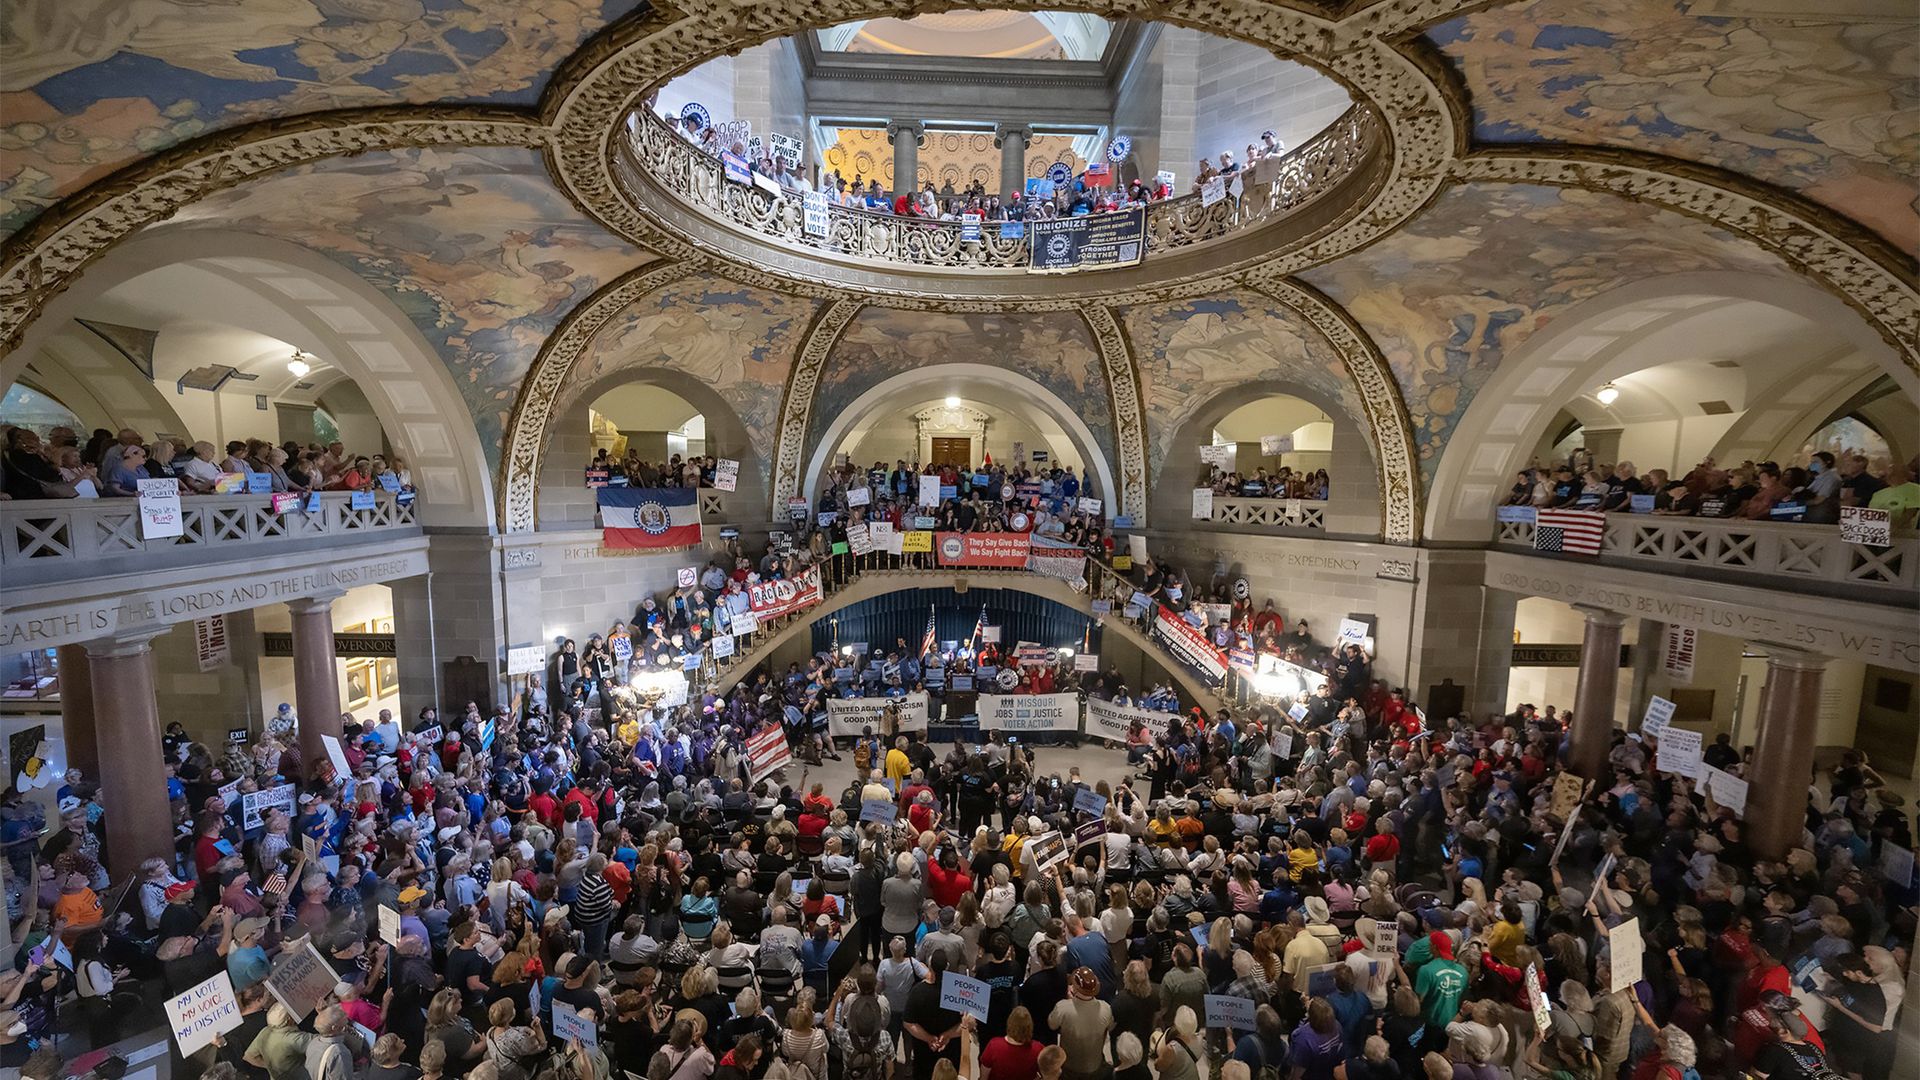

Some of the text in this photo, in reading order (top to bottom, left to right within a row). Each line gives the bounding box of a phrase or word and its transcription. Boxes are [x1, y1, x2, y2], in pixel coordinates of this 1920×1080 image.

[771, 134, 802, 150] STOP THE
[774, 145, 798, 158] POWER
[804, 202, 827, 214] BLOCK
[810, 213, 820, 222] MY
[807, 224, 826, 234] VOTE
[1036, 220, 1087, 230] UNIONIZE
[1078, 251, 1118, 260] TOGETHER
[1840, 508, 1857, 519] IP
[970, 538, 984, 547] They
[985, 539, 996, 547] Say
[981, 550, 992, 558] Say
[994, 549, 1010, 558] Fight
[1253, 552, 1284, 564] PARTY
[1288, 554, 1360, 570] EXPEDIENCY
[90, 610, 108, 630] IS
[111, 603, 156, 625] THE
[161, 590, 225, 616] LORD'S
[230, 584, 268, 604] AND
[270, 578, 300, 597] THE
[303, 568, 358, 590] FULLNESS
[1500, 572, 1528, 588] LORD
[1532, 578, 1562, 595] GOD
[1565, 584, 1584, 597] OF
[1588, 587, 1632, 608] HOSTS
[1636, 596, 1652, 612] BE
[1657, 598, 1704, 622] WITH
[1712, 610, 1733, 628] US
[1840, 630, 1882, 656] WE
[197, 620, 210, 661] Missouri
[1160, 634, 1172, 645] THE
[1171, 643, 1197, 665] SUPREME
[1176, 636, 1187, 645] THE
[1187, 644, 1208, 661] PEOPLE
[1192, 637, 1219, 659] WELFARE
[1666, 633, 1679, 670] Missouri
[1538, 651, 1554, 661] OF
[900, 702, 924, 710] ACISM
[1017, 698, 1056, 708] MISSOURI
[994, 708, 1062, 718] JOBS JUSTICE
[1091, 706, 1117, 718] UNITED
[1118, 713, 1151, 724] AGAINST
[1003, 719, 1054, 728] VOTER ACTION
[1100, 718, 1120, 728] GOOD
[230, 730, 246, 740] EXIT
[1380, 933, 1393, 941] YOU
[270, 950, 314, 987] MISSOURI
[282, 962, 318, 992] DEMANDS
[954, 980, 980, 994] PEOPLE
[177, 978, 220, 1010] MY VOTE
[960, 990, 975, 999] NOT
[182, 991, 225, 1022] MY VOICE
[944, 994, 986, 1014] POLITICIANS
[1216, 1001, 1244, 1010] PEOPLE
[178, 1002, 236, 1040] MY DISTRICT
[563, 1014, 585, 1030] PEOPLE
[1209, 1014, 1254, 1024] POLITICIANS
